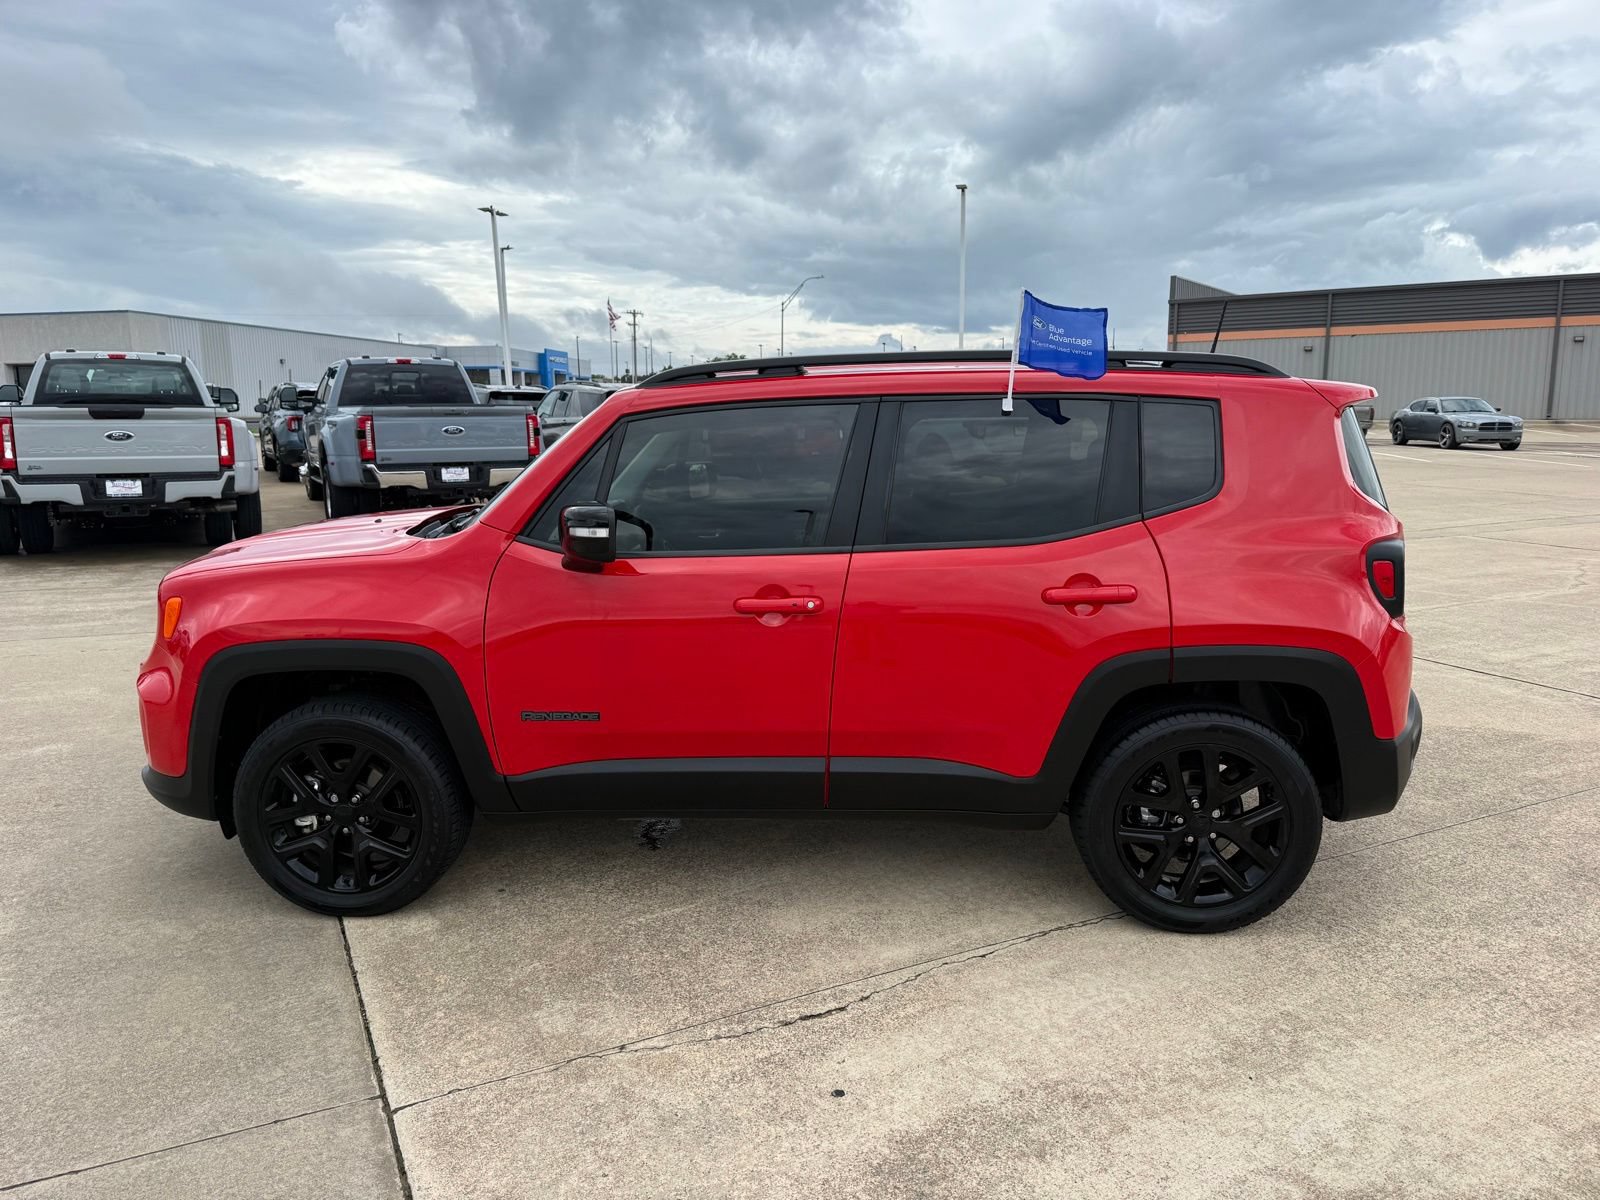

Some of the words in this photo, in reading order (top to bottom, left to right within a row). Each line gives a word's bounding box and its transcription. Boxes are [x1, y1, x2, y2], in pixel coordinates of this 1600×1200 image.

[1048, 324, 1065, 335] Blue
[1049, 333, 1093, 347] Advantage
[521, 711, 600, 721] RENEGADE
